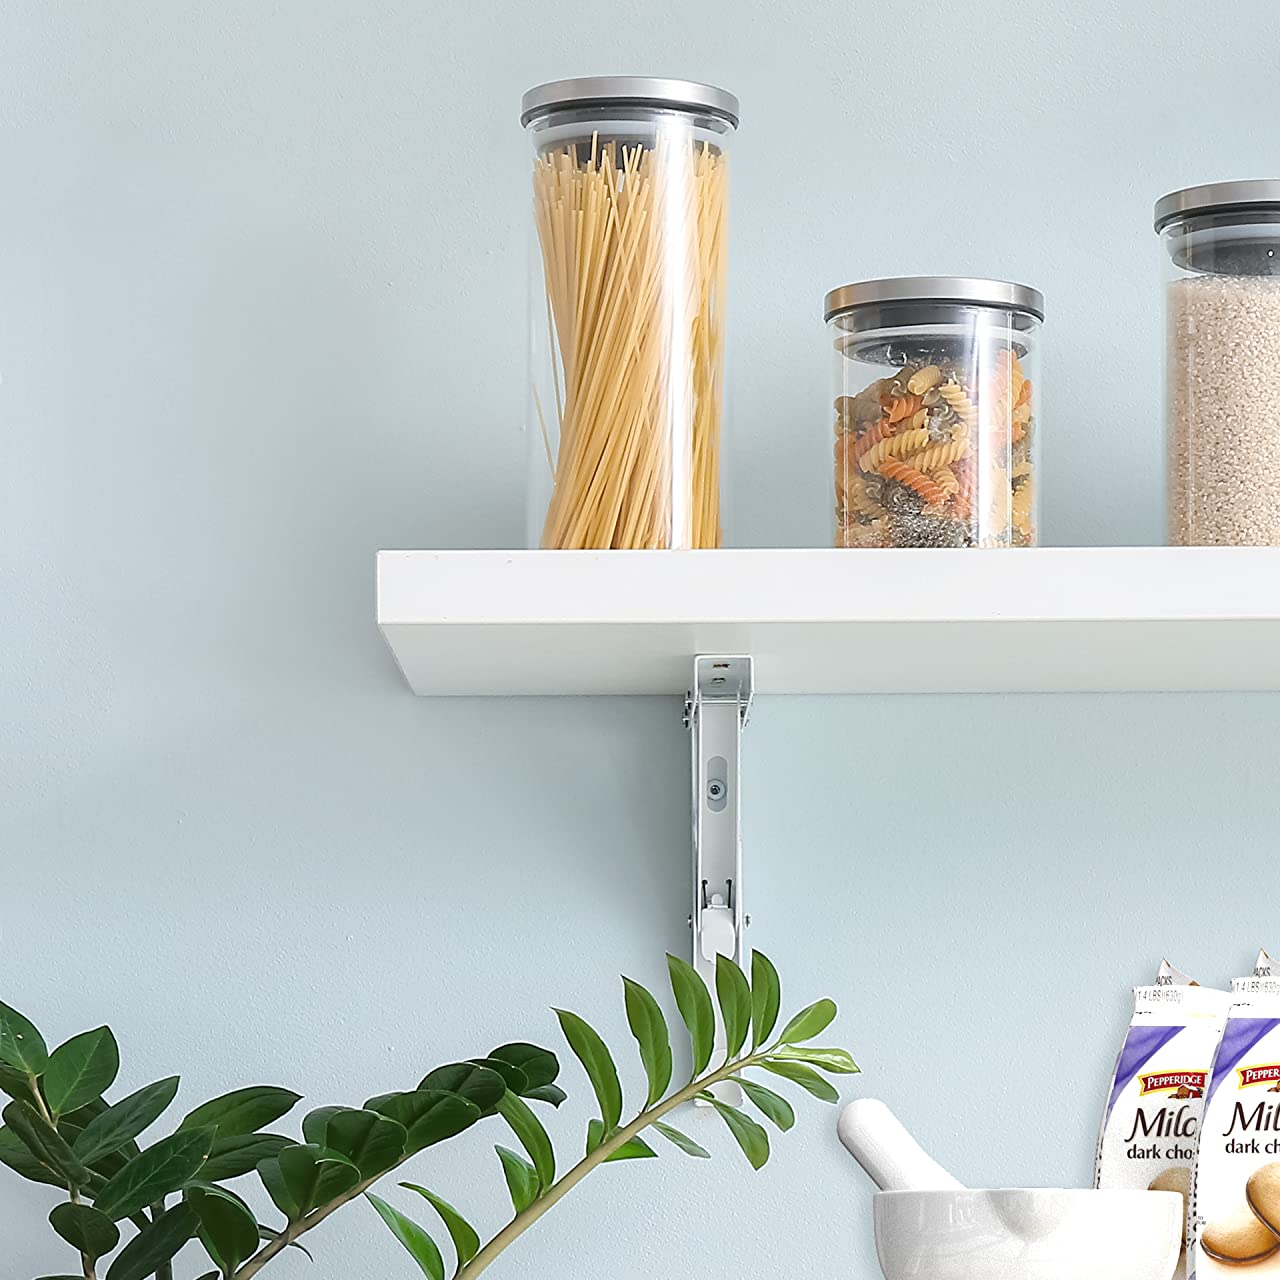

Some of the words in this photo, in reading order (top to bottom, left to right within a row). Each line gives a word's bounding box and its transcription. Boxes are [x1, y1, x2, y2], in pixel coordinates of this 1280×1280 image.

[1147, 1075, 1202, 1089] PEPPERIDGE
[1127, 1144, 1161, 1160] dark
[1225, 1138, 1260, 1154] dark
